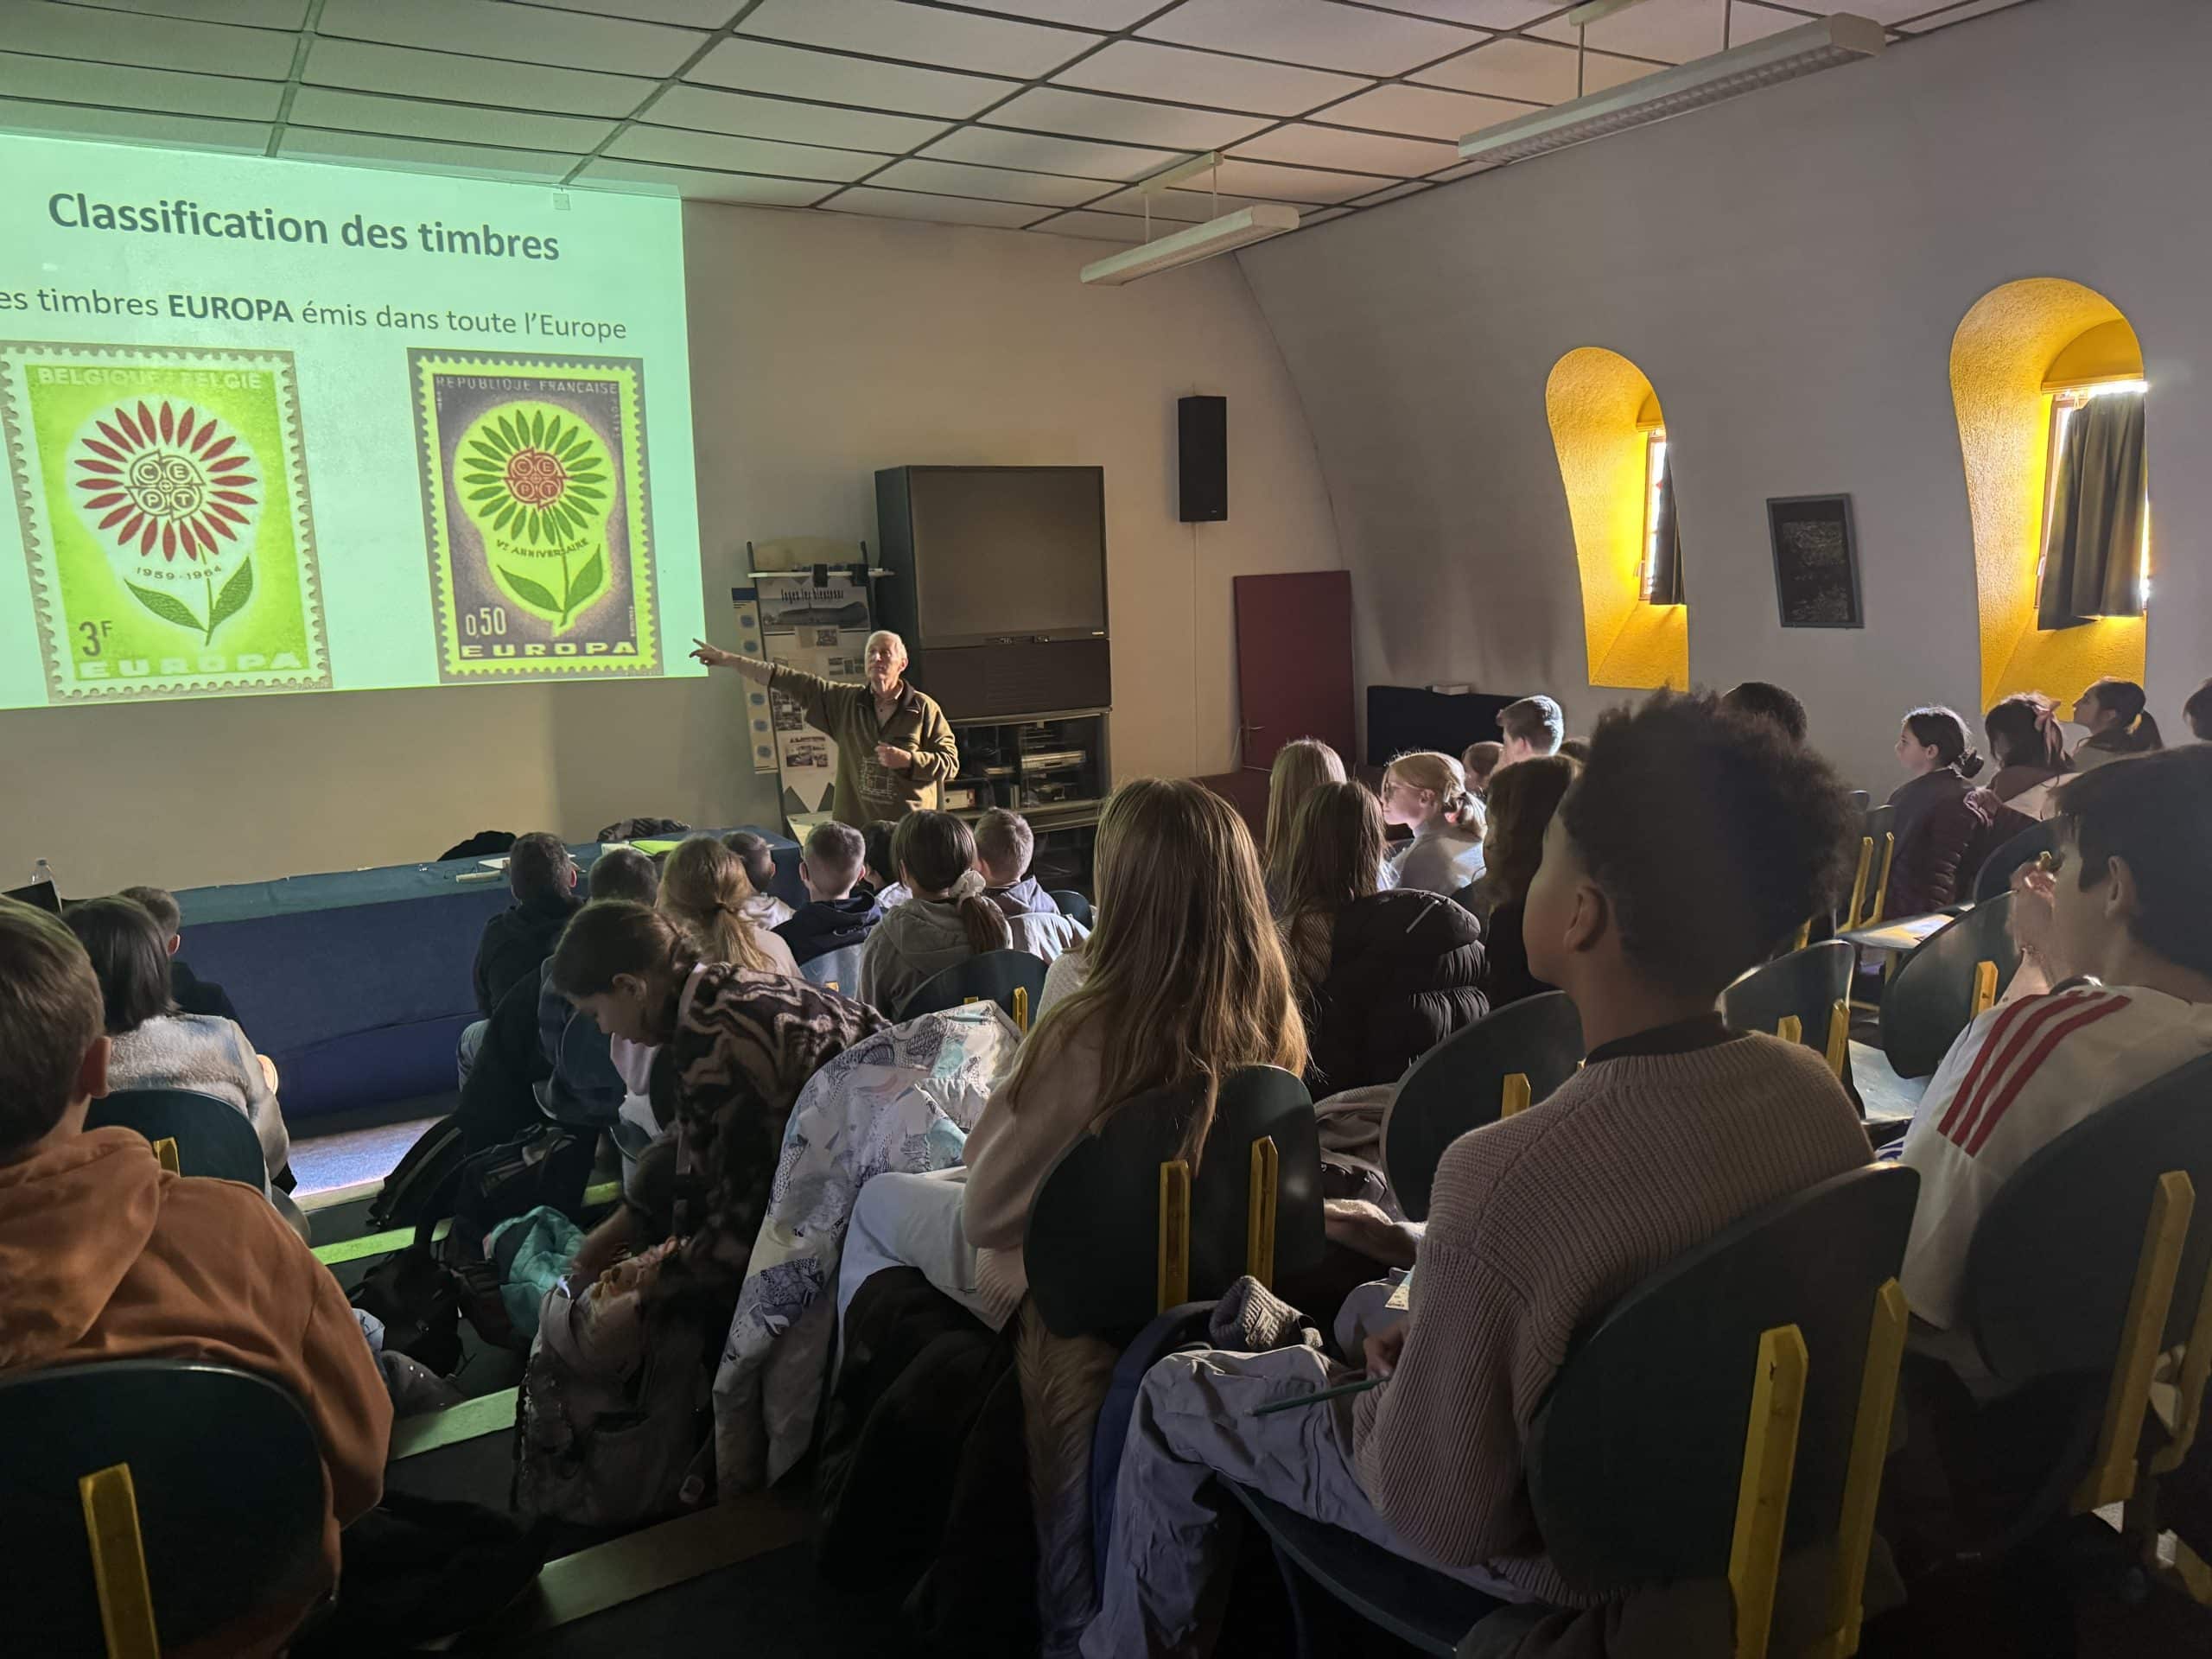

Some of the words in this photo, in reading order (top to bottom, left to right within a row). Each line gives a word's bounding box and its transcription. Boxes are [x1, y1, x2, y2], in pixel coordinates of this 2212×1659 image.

[48, 193, 328, 245] Classification
[340, 214, 408, 249] des
[416, 222, 560, 260] timbres
[36, 288, 159, 316] timbres
[168, 295, 294, 323] EUROPA
[302, 301, 368, 327] émis
[376, 305, 440, 330] dans
[446, 311, 517, 334] toute
[465, 607, 507, 639] 0,50
[79, 652, 304, 679] EUROPA
[461, 641, 638, 658] EUROPA
